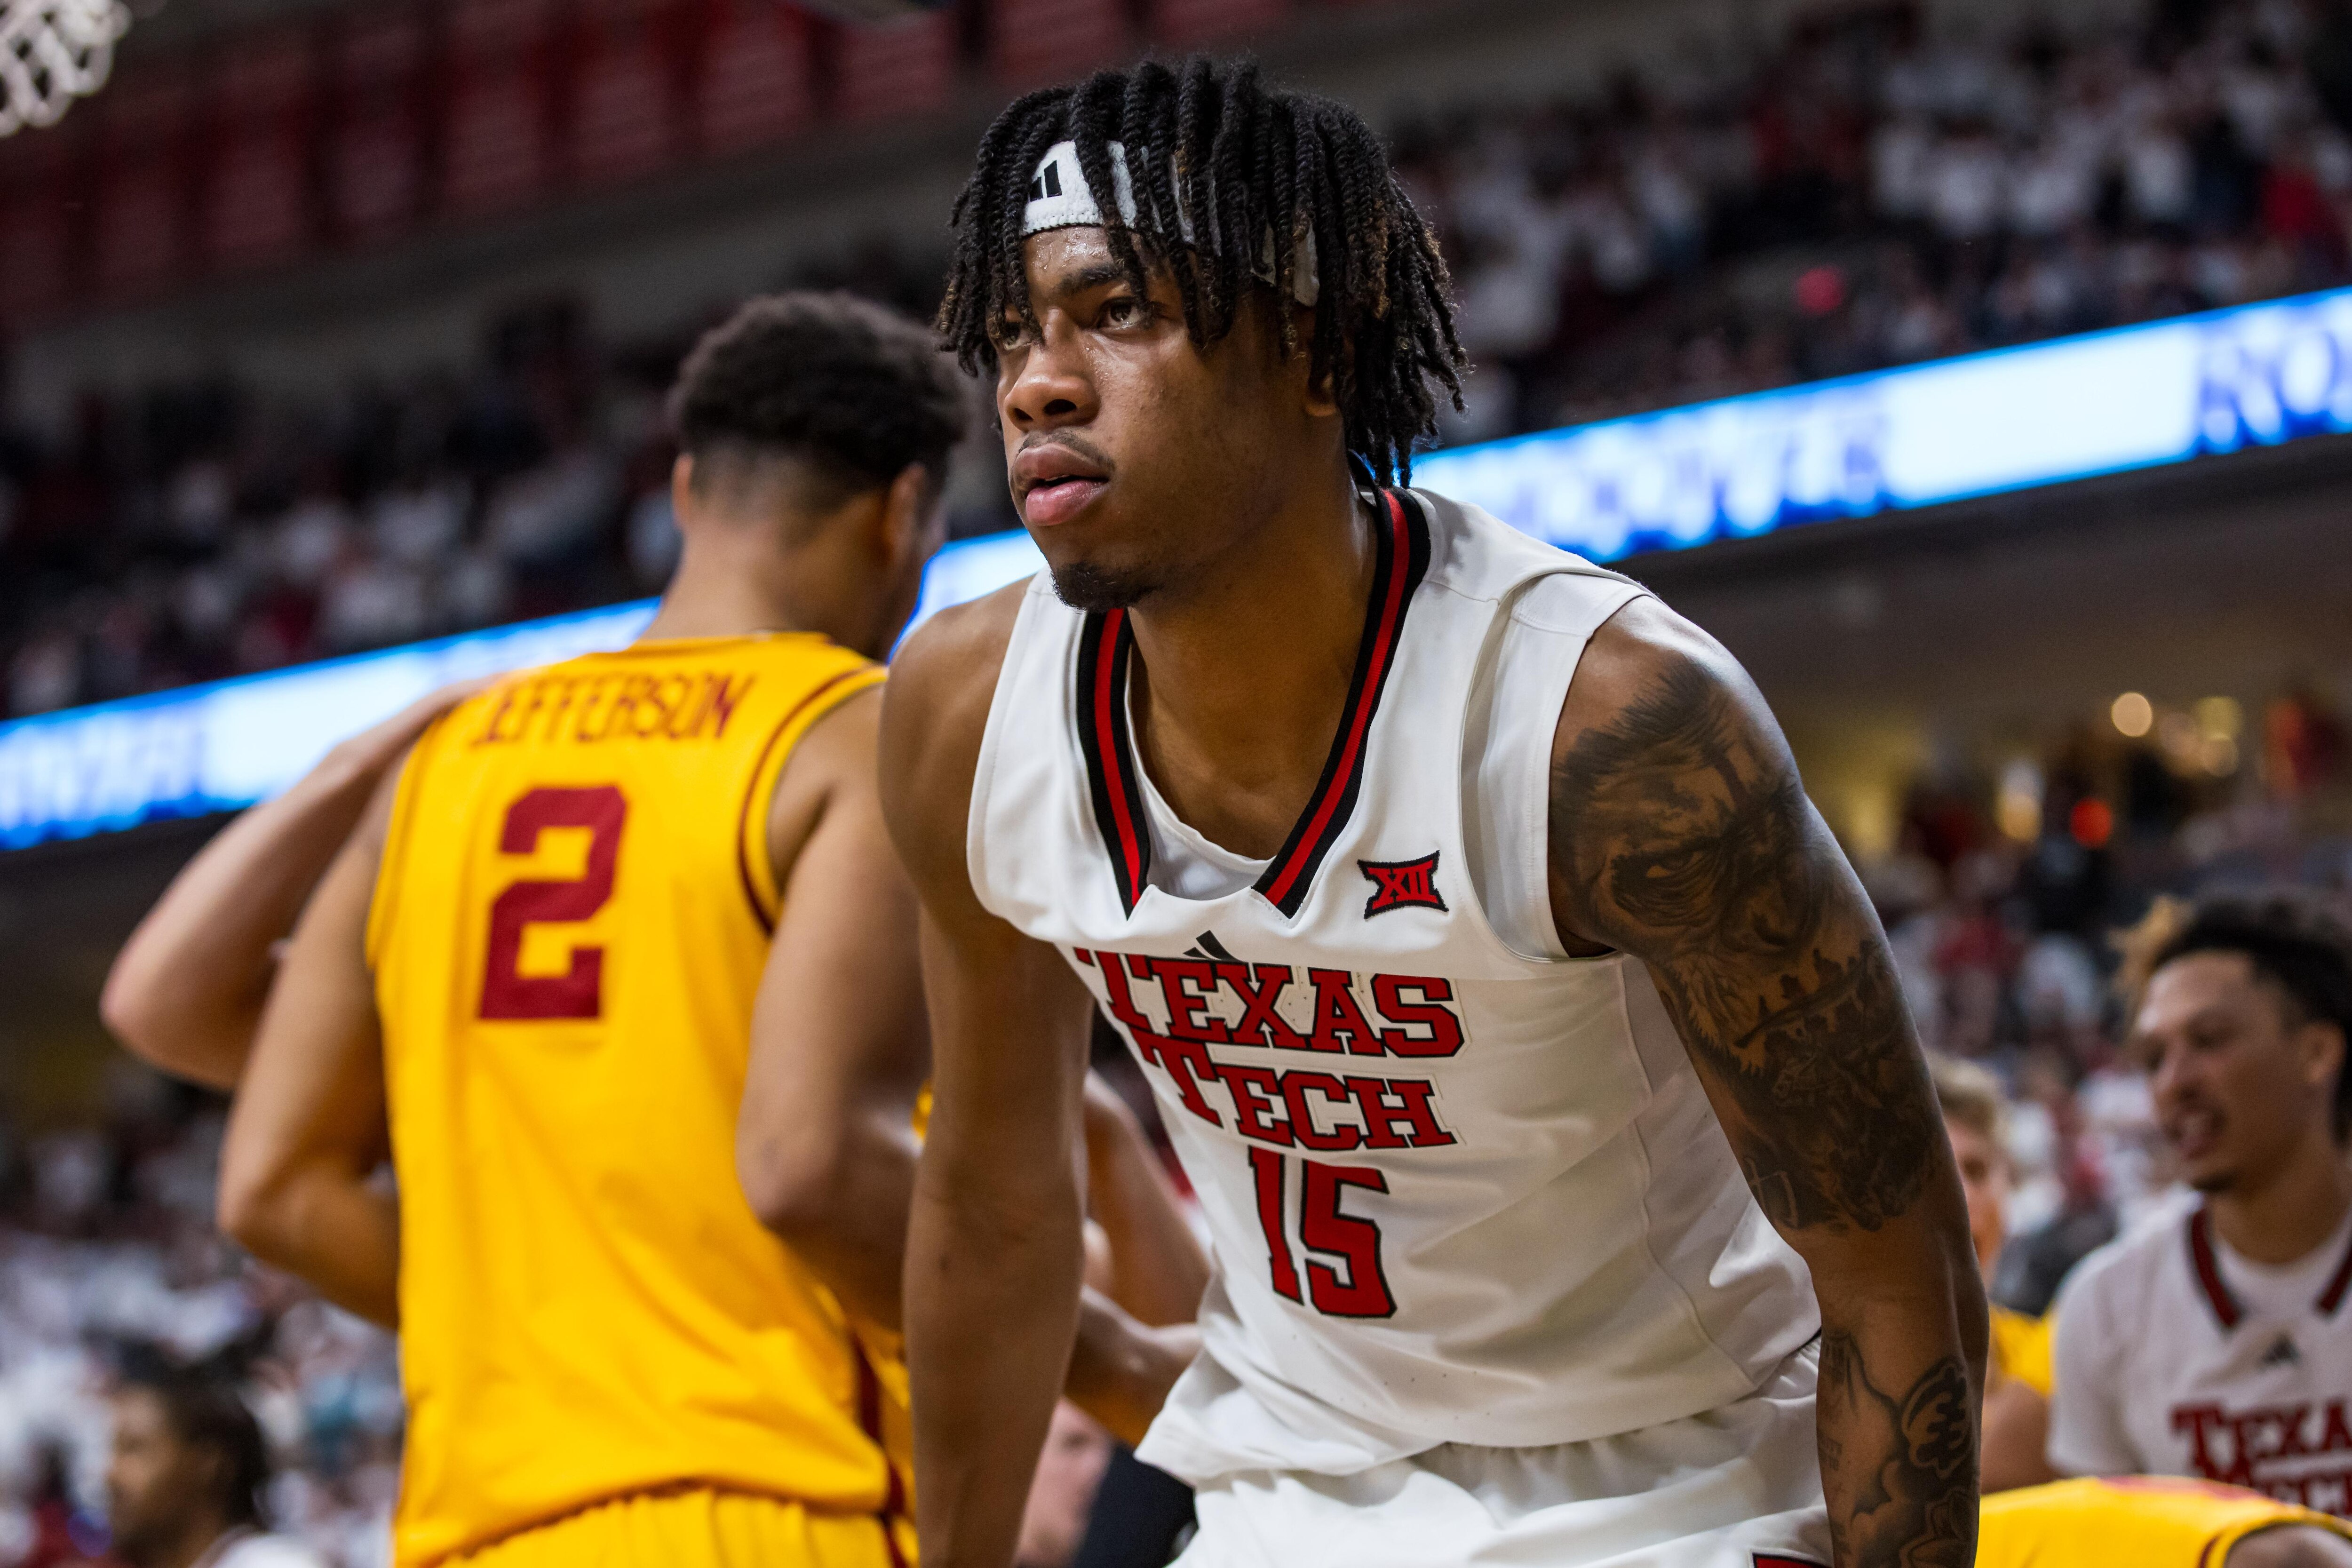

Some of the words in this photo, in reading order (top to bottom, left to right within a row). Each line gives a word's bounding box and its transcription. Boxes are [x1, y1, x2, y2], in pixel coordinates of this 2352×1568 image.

[472, 670, 760, 747] JEFFERSON
[476, 784, 628, 1021] 2
[1072, 946, 1465, 1058] TEXAS
[1127, 1027, 1459, 1151] TECH
[1248, 1144, 1398, 1319] 15
